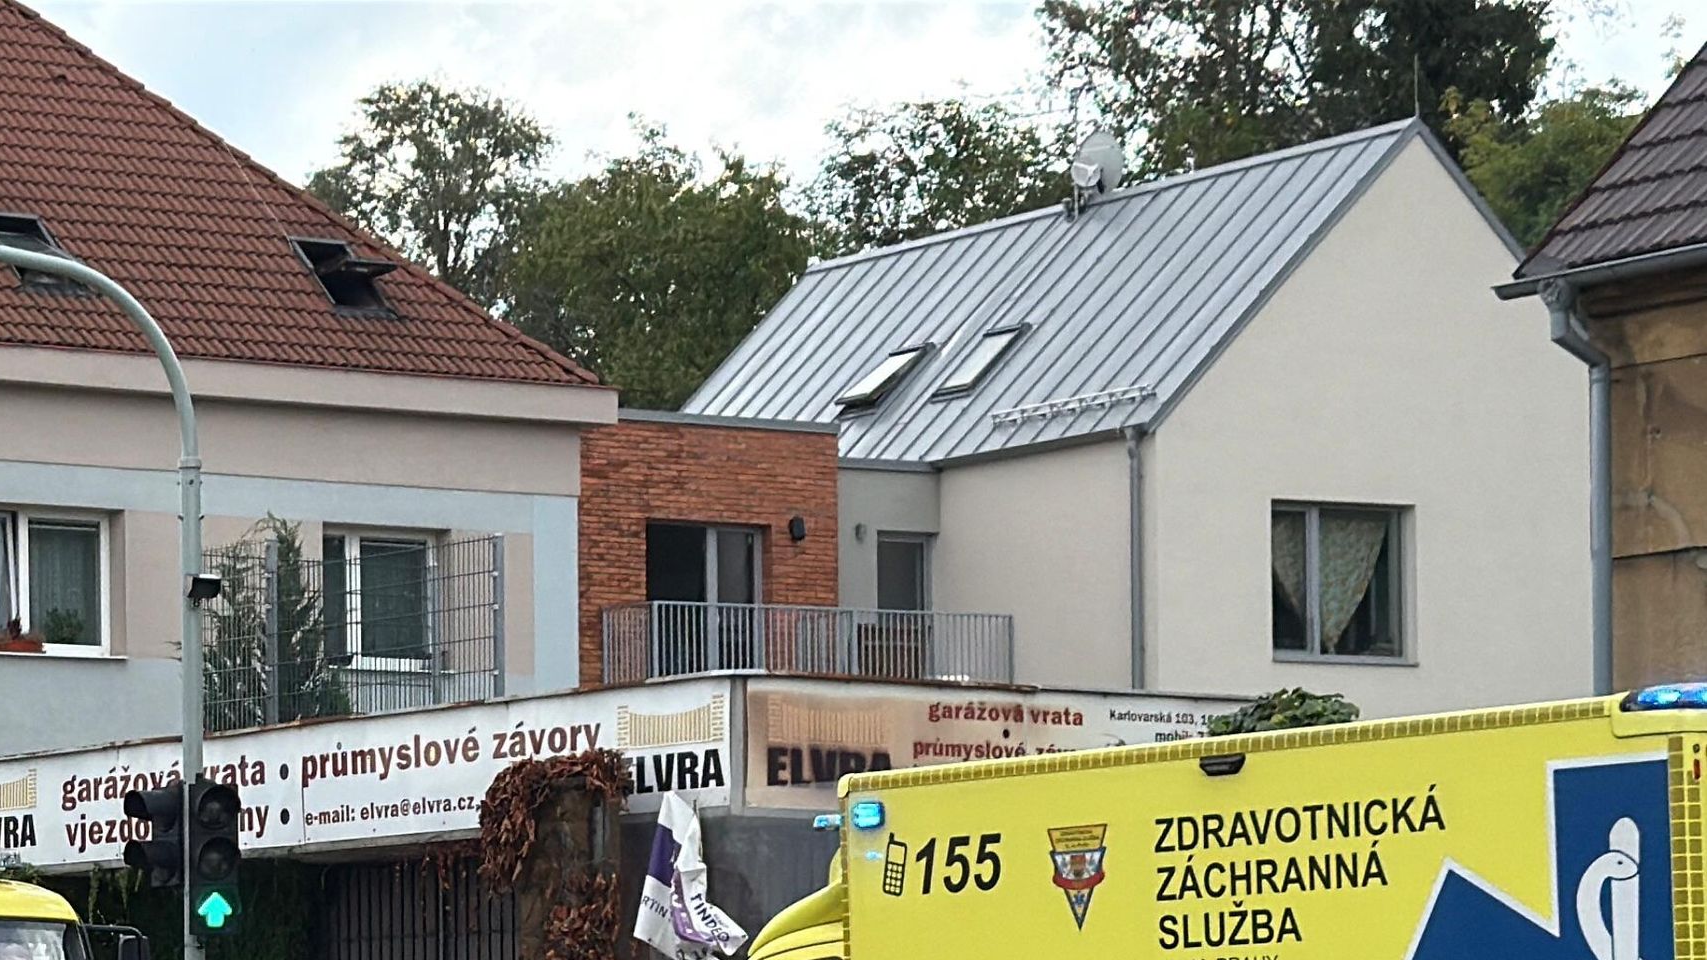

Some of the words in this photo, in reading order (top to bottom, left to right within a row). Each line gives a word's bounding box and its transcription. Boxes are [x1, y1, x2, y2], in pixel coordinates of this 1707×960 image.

[928, 701, 1024, 723] garážová
[1030, 707, 1084, 726] vrata
[1109, 709, 1172, 723] Karlovarská
[61, 760, 181, 812] garážová
[203, 754, 266, 787] rata
[302, 726, 480, 788] průmyslové
[493, 721, 602, 760] závory
[912, 737, 1026, 762] průmyslové
[65, 812, 153, 854] vjezdo
[304, 806, 356, 827] e-mail:
[1154, 784, 1446, 854] ZDRAVOTNICKÁ
[913, 832, 1003, 896] 155
[1156, 842, 1388, 902] ZÁCHRANNÁ
[1158, 900, 1303, 951] SLUŽBA
